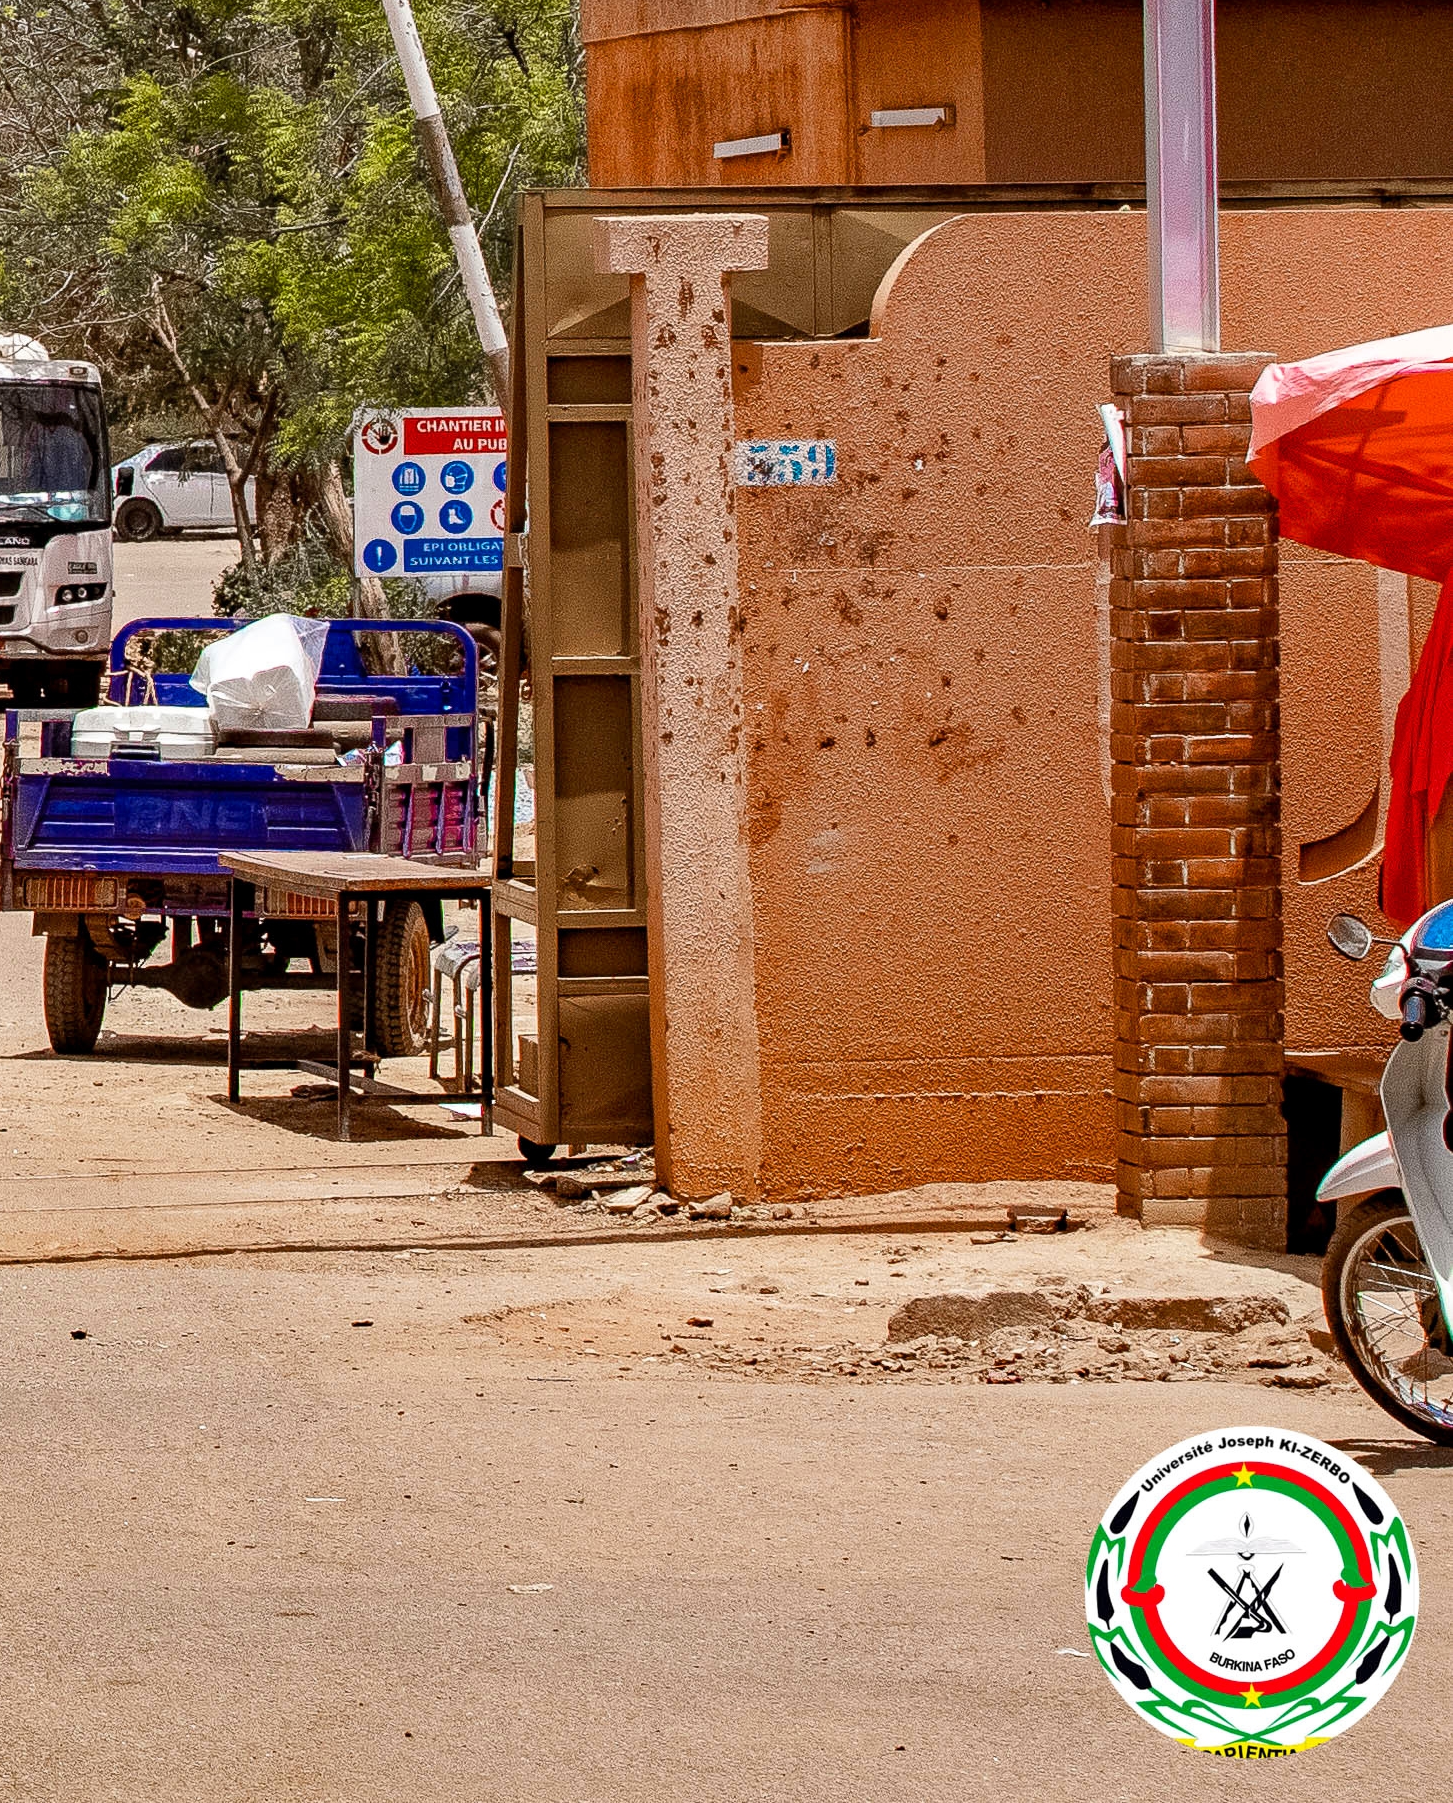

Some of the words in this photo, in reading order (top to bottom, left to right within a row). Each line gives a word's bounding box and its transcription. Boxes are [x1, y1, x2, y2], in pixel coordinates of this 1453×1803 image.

[416, 419, 492, 433] CHANTIER
[452, 438, 474, 451] AU
[422, 542, 445, 552] EPI
[409, 556, 470, 566] SUIVANT
[474, 555, 499, 565] LES
